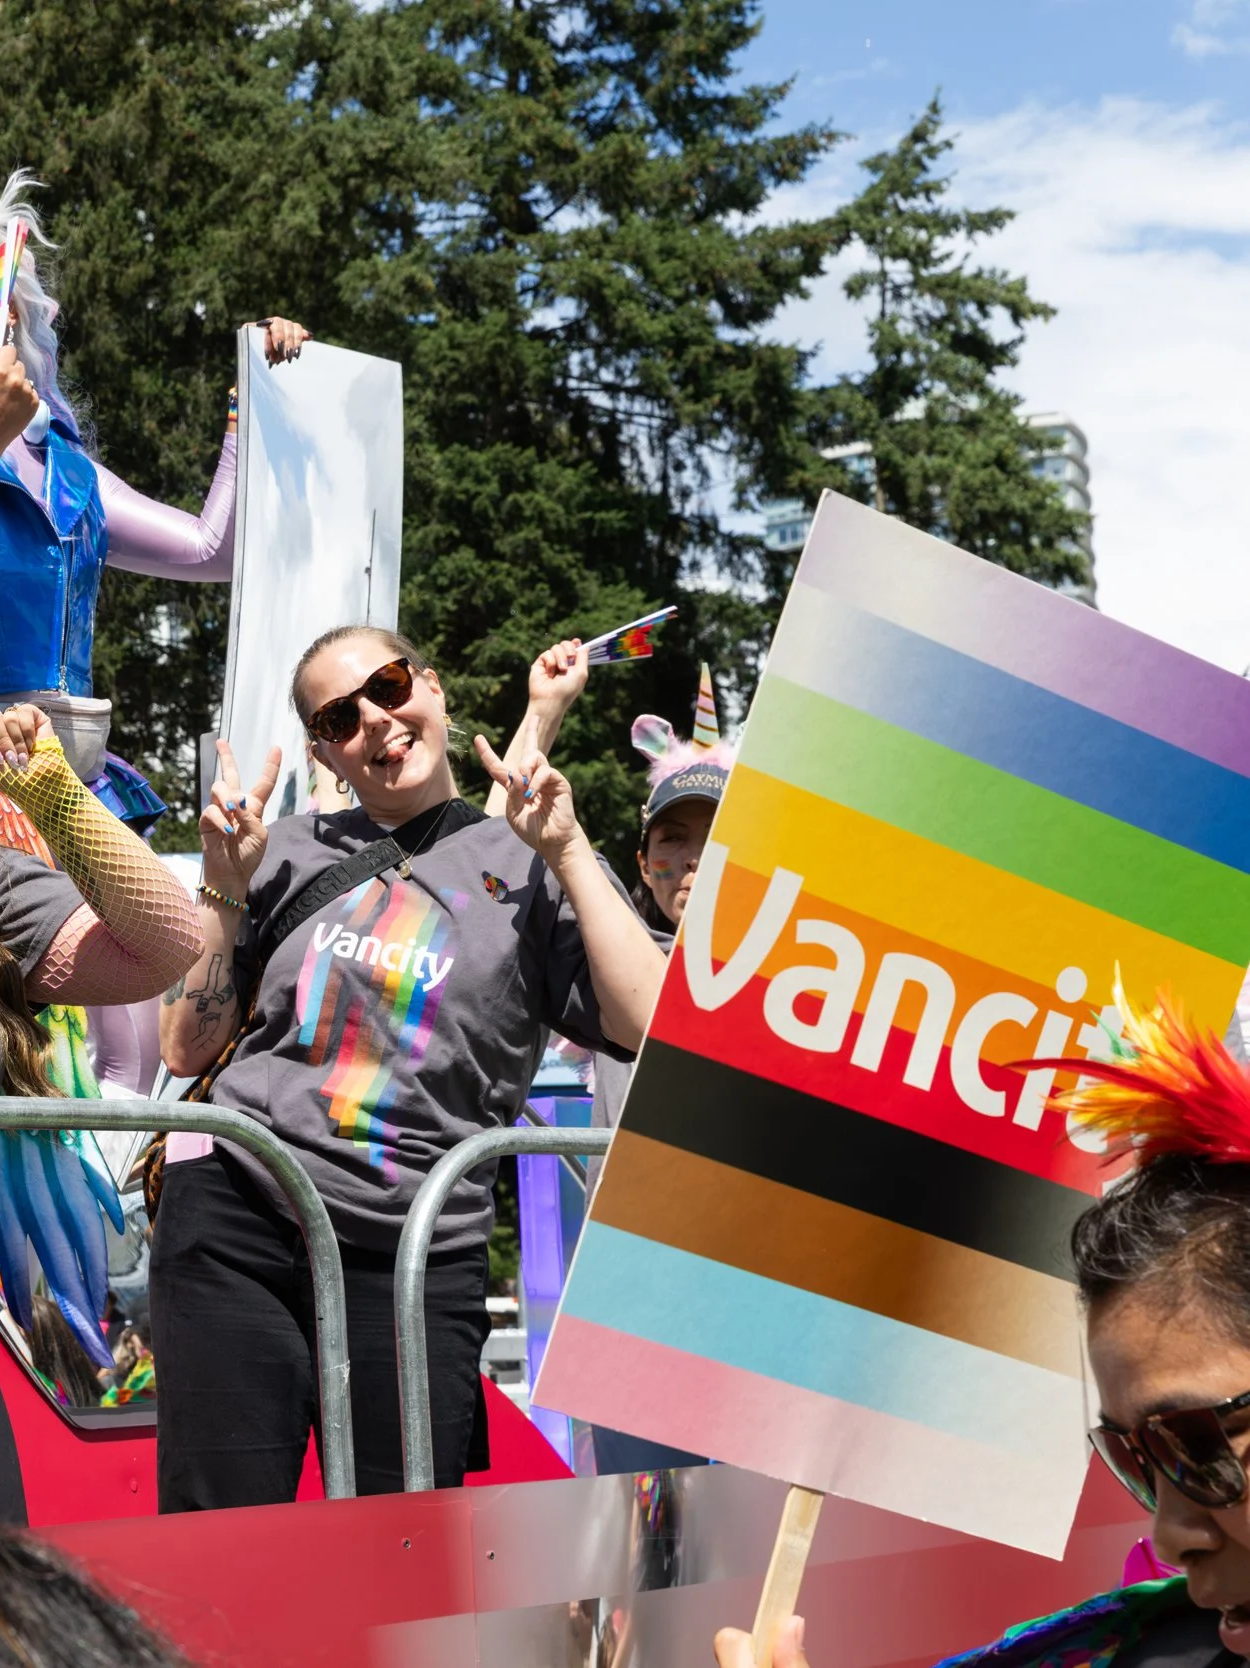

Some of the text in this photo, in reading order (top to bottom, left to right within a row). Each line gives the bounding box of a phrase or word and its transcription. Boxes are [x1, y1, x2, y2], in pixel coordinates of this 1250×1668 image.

[672, 773, 726, 786] CAYMU
[272, 864, 352, 941] BAGGU
[313, 922, 454, 992] Vancity
[684, 840, 1142, 1198] Vancit
